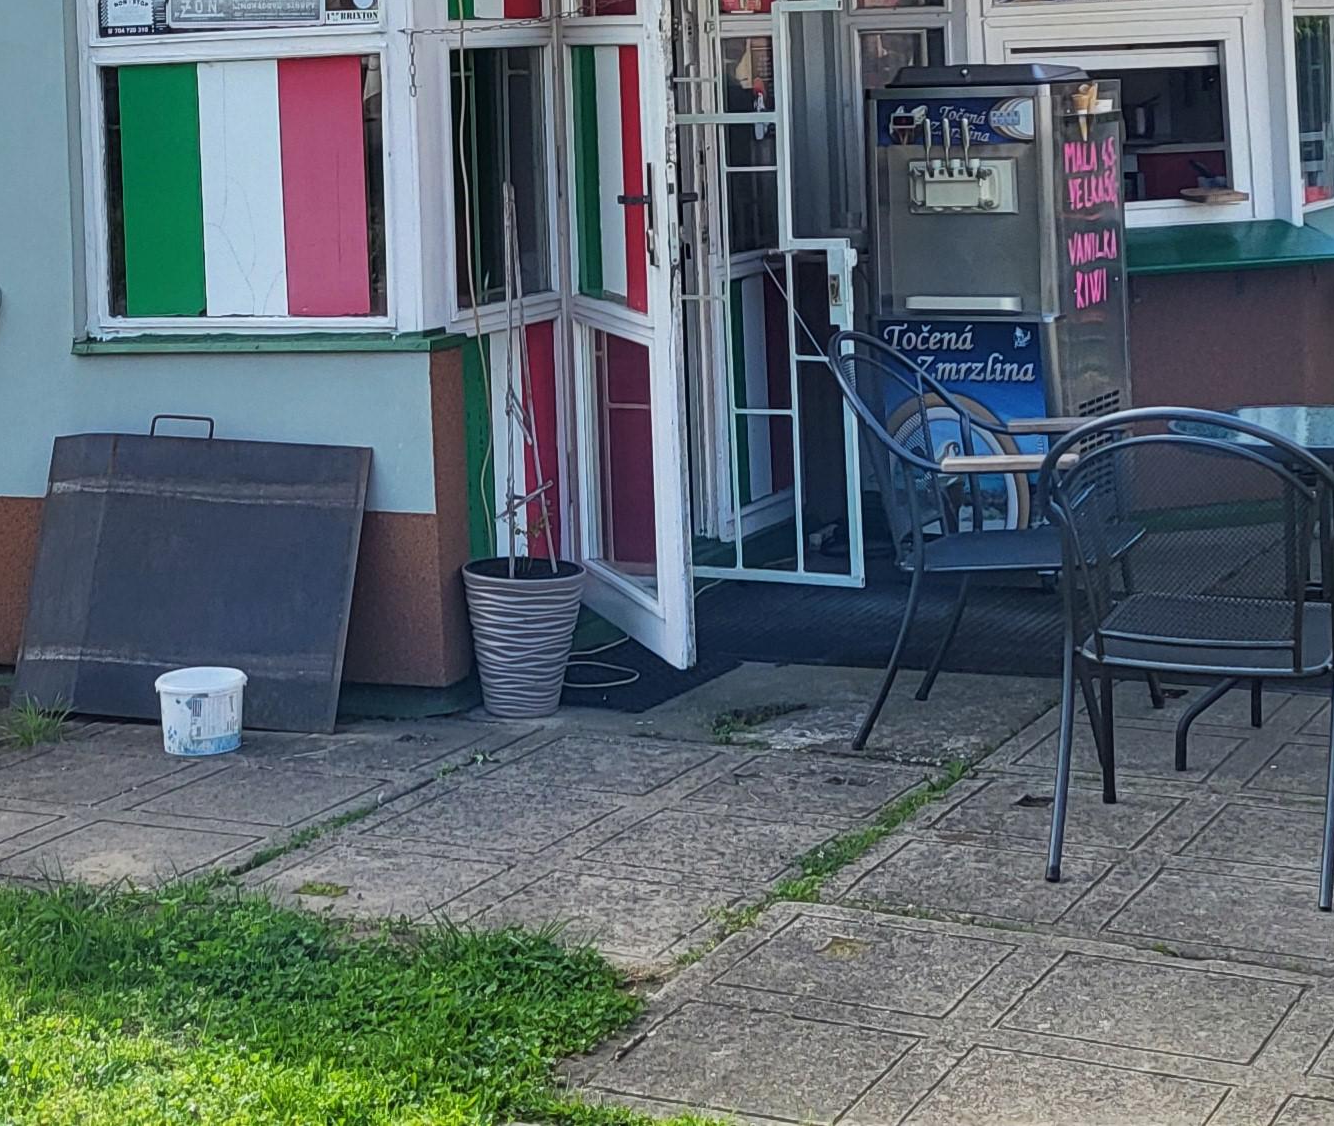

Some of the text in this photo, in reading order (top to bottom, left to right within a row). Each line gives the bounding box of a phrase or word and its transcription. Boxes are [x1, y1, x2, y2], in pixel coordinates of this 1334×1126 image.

[340, 10, 378, 21] BRIXTON
[1068, 228, 1116, 266] VANILKA
[1076, 268, 1107, 309] KIWI
[883, 324, 974, 352] Točená
[916, 352, 1035, 384] Zmrzlina
